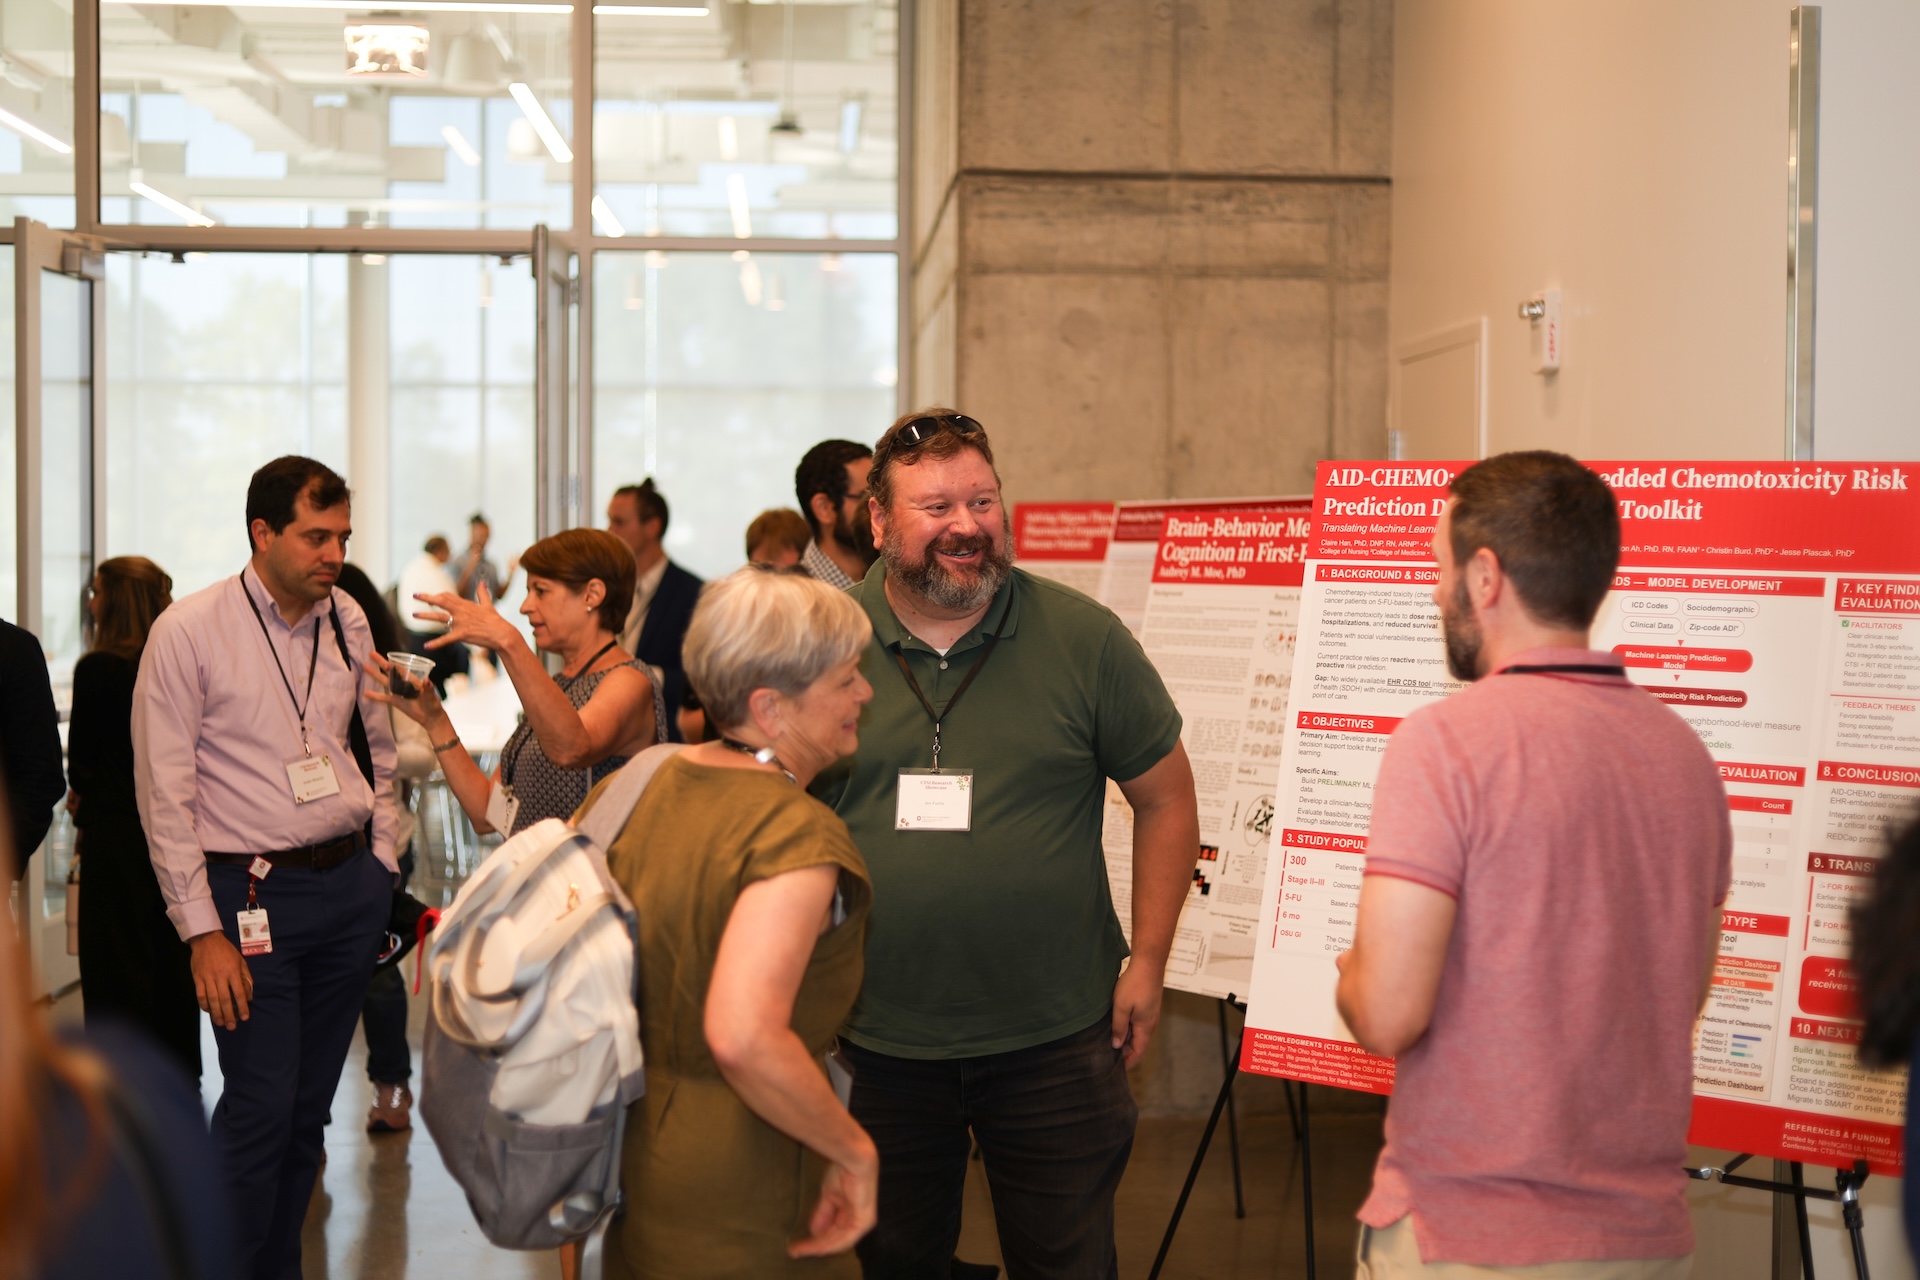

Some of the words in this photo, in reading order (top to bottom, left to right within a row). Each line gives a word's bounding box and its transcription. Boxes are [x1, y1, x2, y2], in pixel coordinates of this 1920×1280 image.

[1325, 468, 1455, 487] AID-CHEMO:
[1671, 467, 1846, 495] Chemotoxicity
[1851, 468, 1909, 490] Risk
[1322, 496, 1427, 517] Prediction
[1620, 499, 1703, 520] Toolkit
[1166, 515, 1285, 538] Brain-Behavior
[1321, 522, 1367, 535] Translating
[1369, 523, 1406, 534] Machine
[1162, 540, 1235, 567] Cognition
[1237, 540, 1254, 563] in
[1348, 548, 1369, 556] Nursing
[1643, 545, 1660, 553] PhD,
[1706, 546, 1733, 554] Christin
[1734, 547, 1753, 555] Burd,
[1780, 548, 1801, 556] Jesse
[1802, 549, 1833, 557] Plascak,
[1158, 566, 1188, 580] Aubrey
[1190, 566, 1202, 578] M.
[1203, 567, 1224, 580] Moe,
[1226, 567, 1246, 579] PhD
[1320, 569, 1328, 577] 1.
[1331, 569, 1402, 580] BACKGROUND
[1404, 571, 1412, 580] &
[1648, 578, 1689, 589] MODEL
[1692, 578, 1783, 591] DEVELOPMENT
[1843, 583, 1853, 593] 7.
[1856, 584, 1883, 594] KEY
[1646, 602, 1668, 610] Codes
[1686, 603, 1755, 614] Sociodemographic
[1322, 609, 1343, 617] Severe
[1344, 611, 1384, 619] chemotoxicity
[1321, 618, 1371, 627] hospitalizations,
[1629, 621, 1656, 629] Clinical
[1657, 622, 1674, 630] Data
[1689, 623, 1721, 632] Zip-code
[1851, 621, 1903, 630] FACILITATORS
[1625, 651, 1655, 659] Machine
[1656, 652, 1688, 662] Learning
[1689, 653, 1727, 663] Prediction
[1663, 661, 1686, 669] Model
[1314, 674, 1329, 682] Gap:
[1340, 676, 1359, 684] widely
[1387, 678, 1402, 686] EHR
[1402, 679, 1417, 687] CDS
[1418, 680, 1431, 688] tool
[1432, 681, 1463, 689] integrates
[1650, 692, 1689, 702] motoxicity
[1689, 693, 1705, 701] Risk
[1706, 693, 1743, 703] Prediction
[1842, 701, 1884, 710] FEEDBACK
[1885, 703, 1916, 711] THEMES
[1301, 715, 1310, 725] 2.
[1312, 716, 1375, 729] OBJECTIVES
[1764, 722, 1801, 732] measure
[1300, 731, 1324, 740] Primary
[1341, 734, 1365, 743] Develop
[1296, 766, 1320, 775] Specific
[1719, 766, 1798, 782] EVALUATION
[1823, 766, 1834, 777] 8.
[1301, 777, 1316, 785] Build
[1317, 778, 1362, 788] PRELIMINARY
[1362, 781, 1372, 789] ML
[1831, 788, 1876, 798] AID-CHEMO
[1762, 801, 1785, 810] Count
[1286, 833, 1294, 843] 3.
[1297, 834, 1330, 846] STUDY
[1332, 838, 1366, 850] POPUL
[1826, 832, 1857, 842] REDCap
[1290, 855, 1307, 866] 300
[1814, 857, 1824, 868] 9.
[1335, 863, 1357, 872] Patients
[1287, 875, 1308, 886] Stage
[1827, 883, 1843, 891] FOR
[1285, 893, 1302, 902] 5-FU
[1330, 899, 1348, 908] Based
[1328, 917, 1352, 927] Baseline
[1280, 929, 1293, 937] OSU
[1294, 930, 1302, 938] GI
[1720, 933, 1738, 942] Tool
[1326, 935, 1337, 943] The
[1337, 936, 1351, 945] Ohio
[1744, 960, 1777, 970] Dashboard
[1808, 979, 1848, 991] receives
[1797, 1023, 1814, 1035] 10.
[1817, 1025, 1852, 1040] NEXT
[1254, 1032, 1322, 1048] ACKNOWLEDGMENTS
[1323, 1043, 1342, 1051] (CTSI
[1343, 1046, 1366, 1055] SPARK
[1693, 1075, 1727, 1086] Prediction
[1727, 1080, 1764, 1092] Dashboard
[1790, 1075, 1820, 1086] Expand
[1827, 1080, 1862, 1091] additional
[1863, 1086, 1889, 1095] cancer
[1787, 1093, 1813, 1105] Migrate
[1815, 1097, 1822, 1105] to
[1823, 1099, 1852, 1110] SMART
[1853, 1103, 1863, 1111] on
[1864, 1105, 1885, 1114] FHIR
[1886, 1107, 1896, 1116] for
[1784, 1122, 1841, 1138] REFERENCES
[1843, 1131, 1850, 1139] &
[1851, 1132, 1891, 1145] FUNDING
